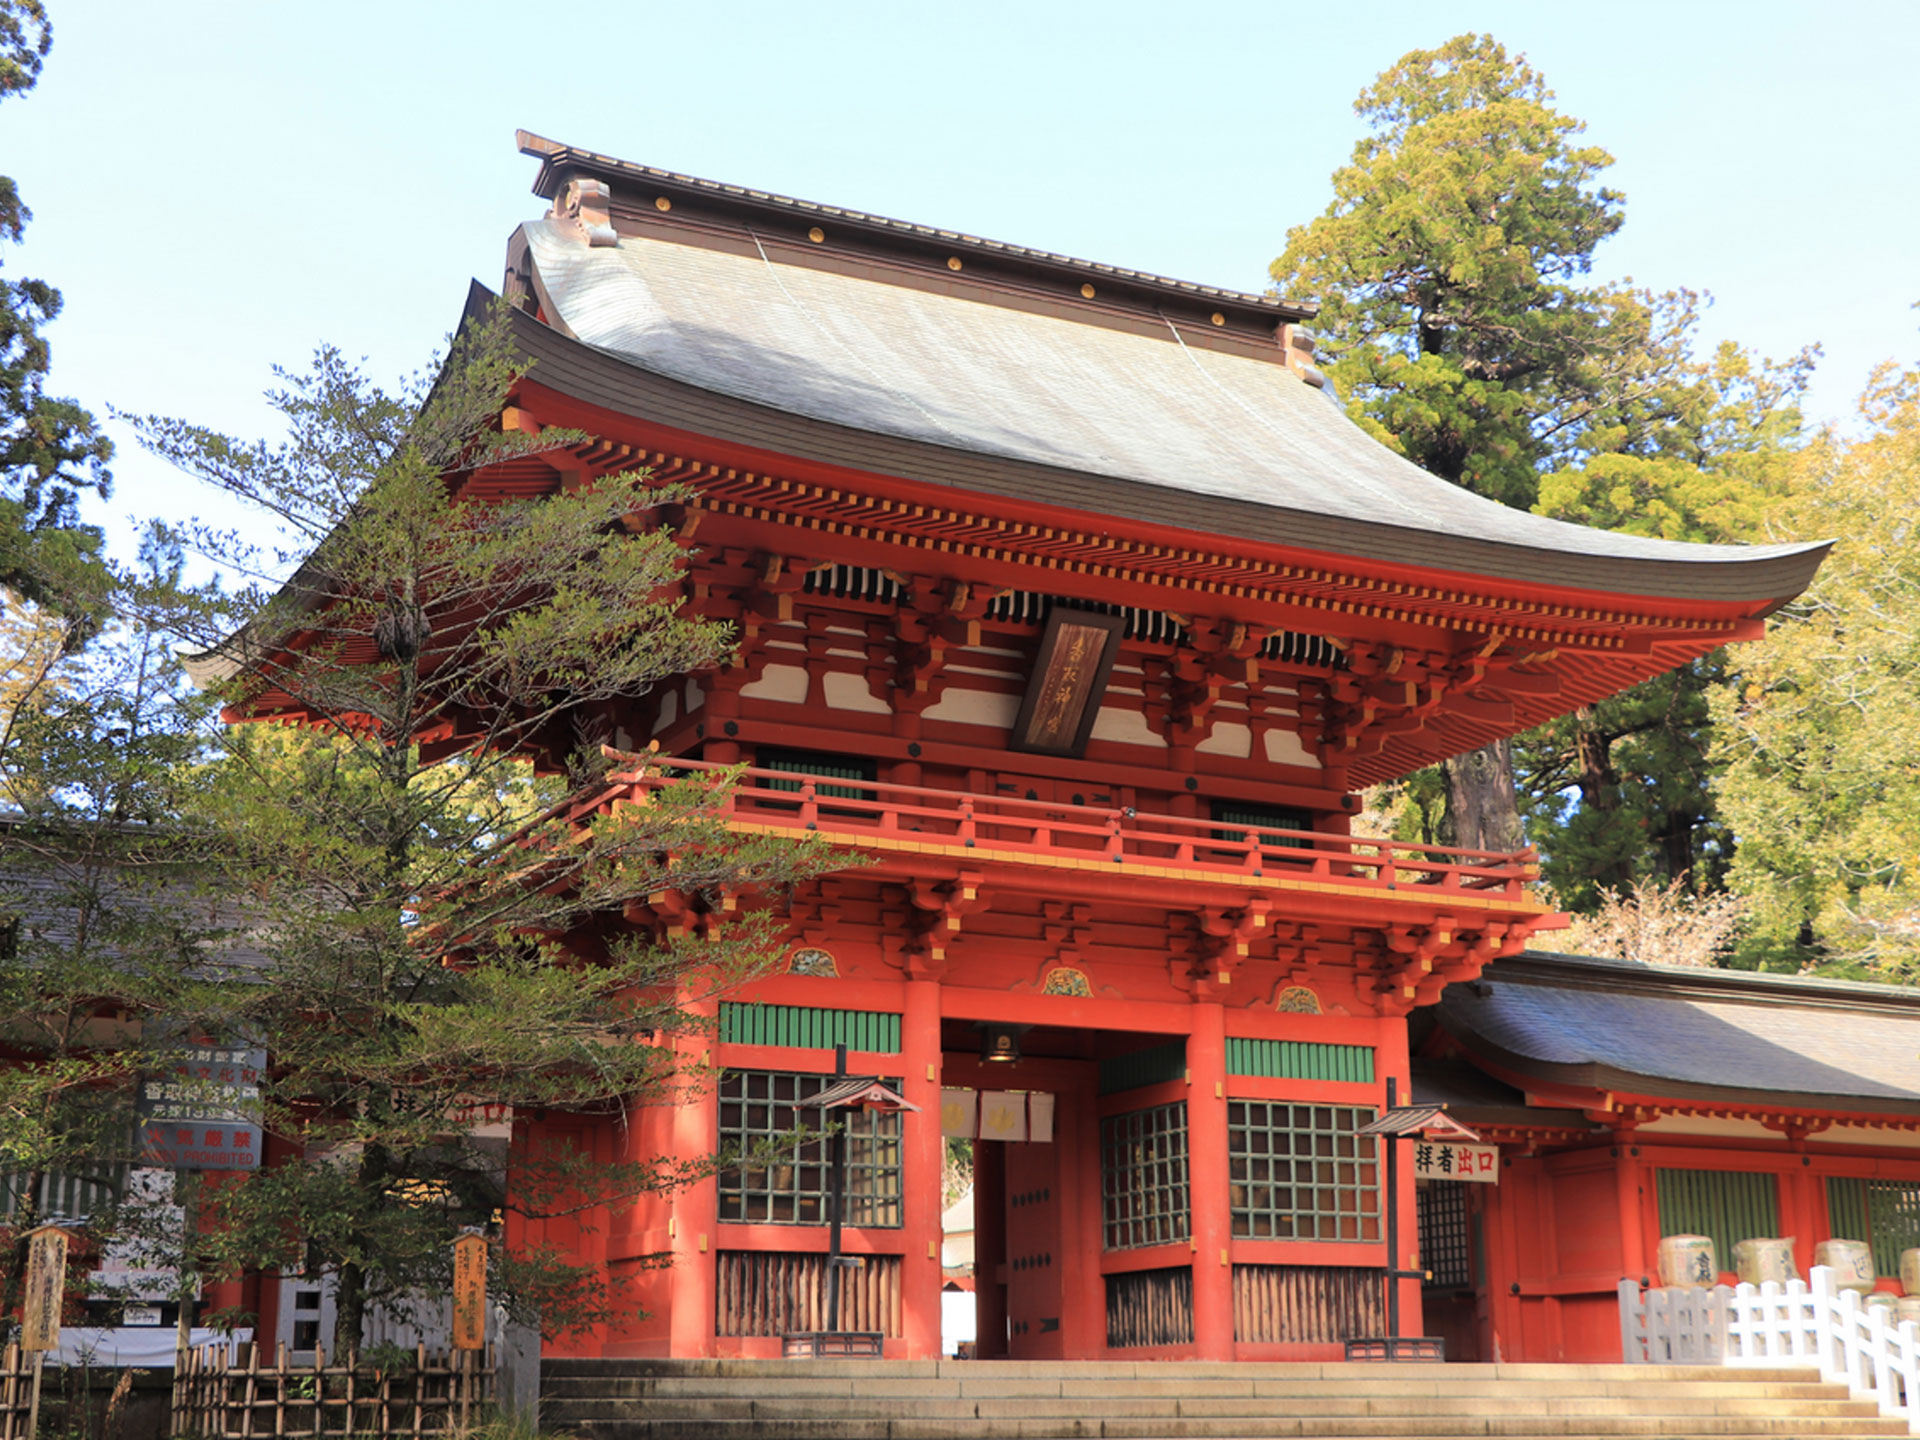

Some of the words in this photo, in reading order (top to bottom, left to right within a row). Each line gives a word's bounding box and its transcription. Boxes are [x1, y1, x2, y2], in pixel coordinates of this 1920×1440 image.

[146, 1127, 252, 1149] 火気厳禁
[183, 1150, 254, 1166] PROHIBITED
